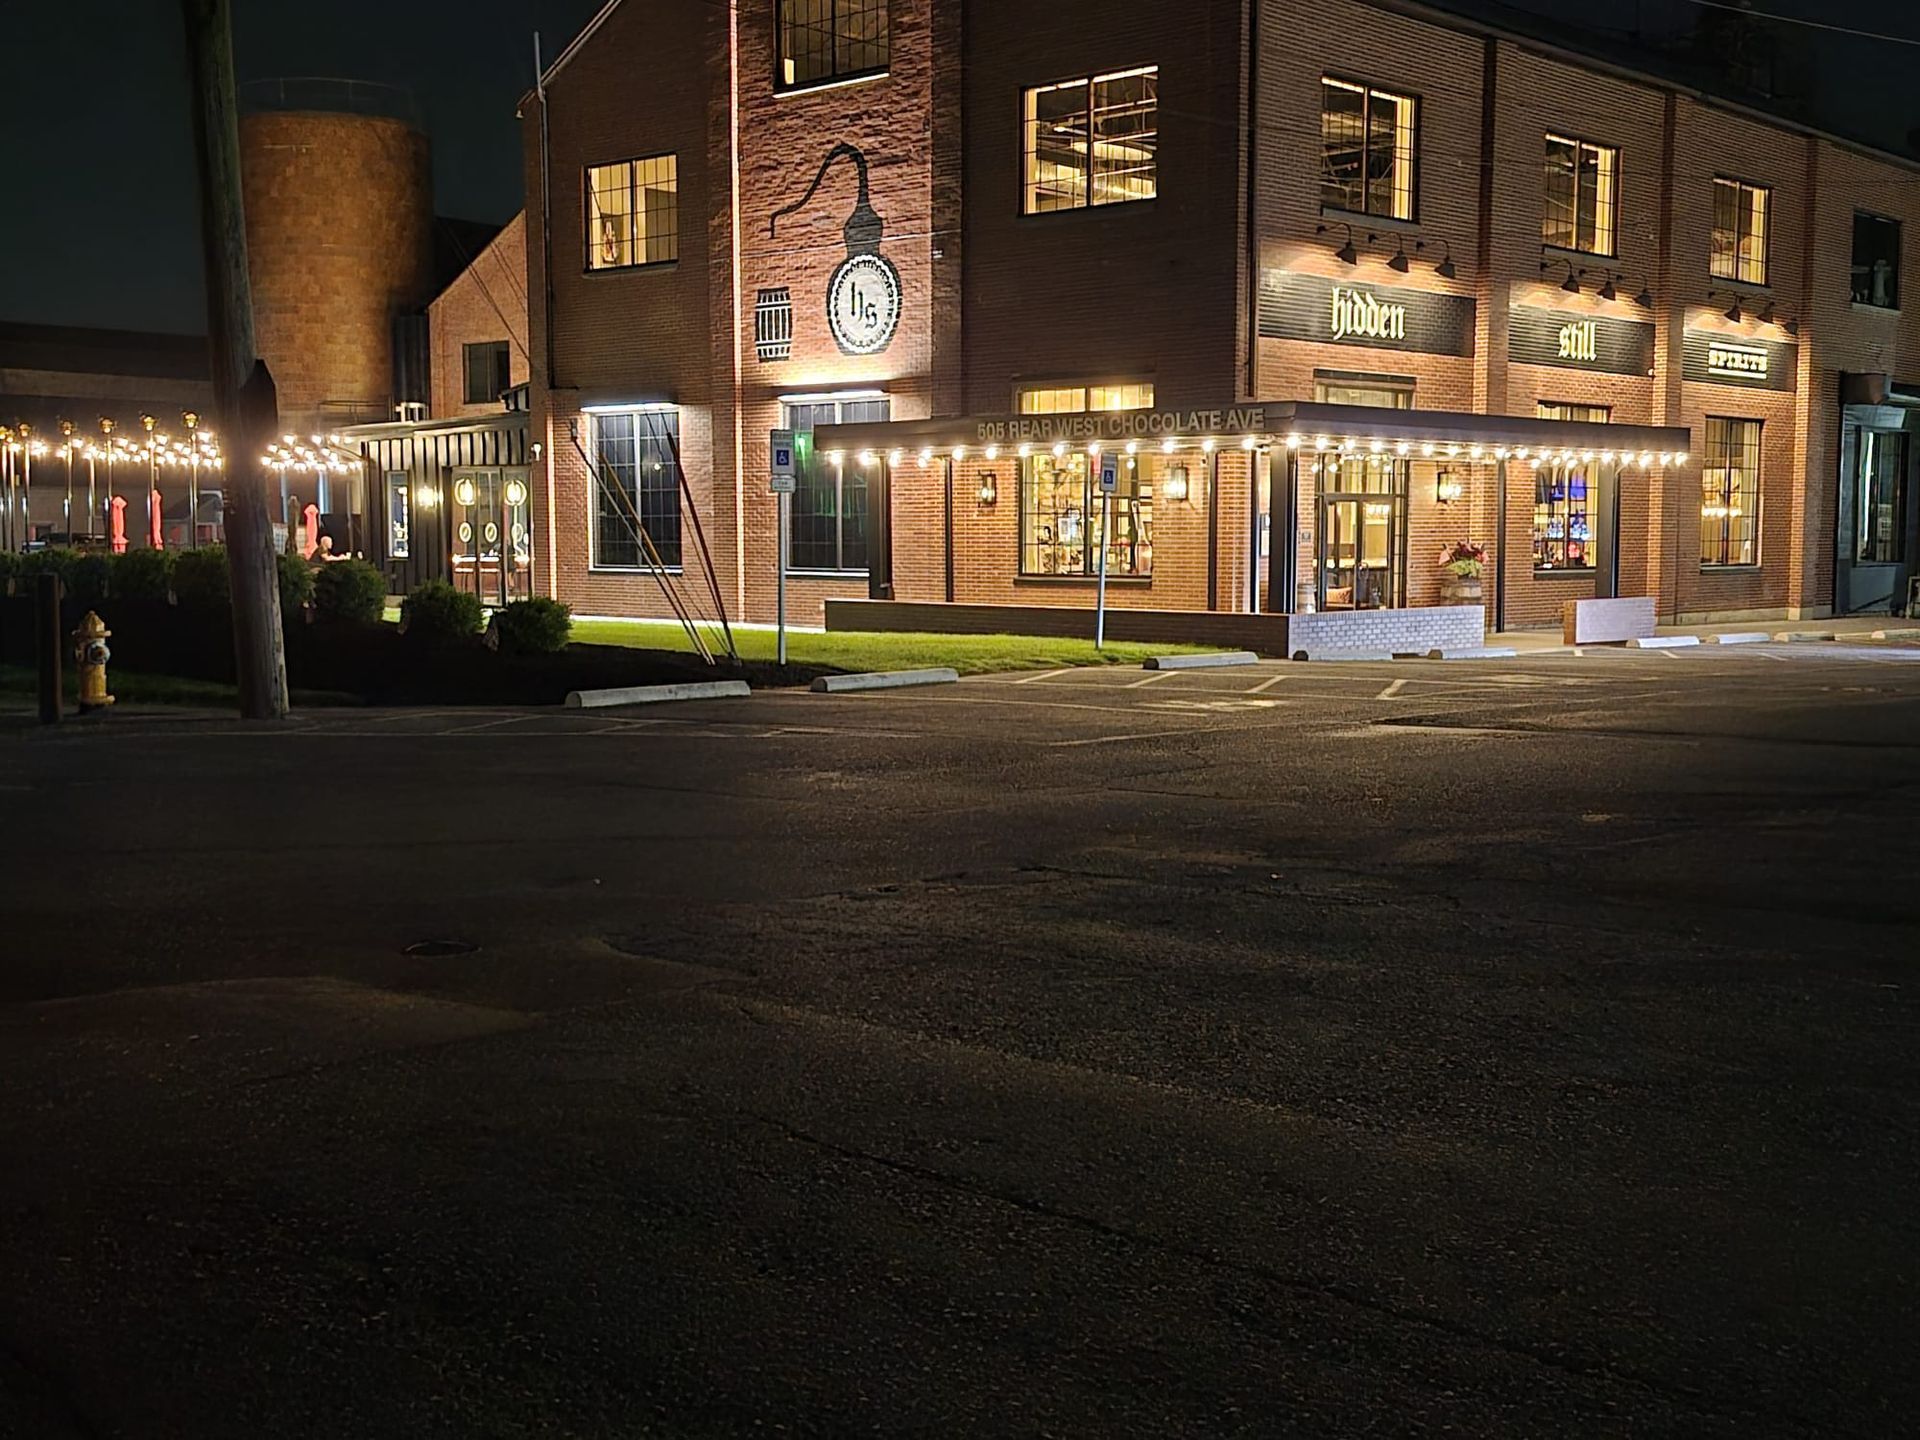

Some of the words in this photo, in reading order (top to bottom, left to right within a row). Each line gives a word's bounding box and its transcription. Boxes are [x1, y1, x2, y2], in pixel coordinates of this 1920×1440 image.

[1331, 286, 1406, 340] hidden
[1558, 320, 1597, 362] still
[1708, 349, 1768, 372] SPIRITS
[977, 422, 1005, 440] 505
[1009, 419, 1052, 440] REAR
[1056, 415, 1106, 438] WEST
[1109, 409, 1222, 435] CHOCOLATE
[1225, 408, 1265, 430] AVE
